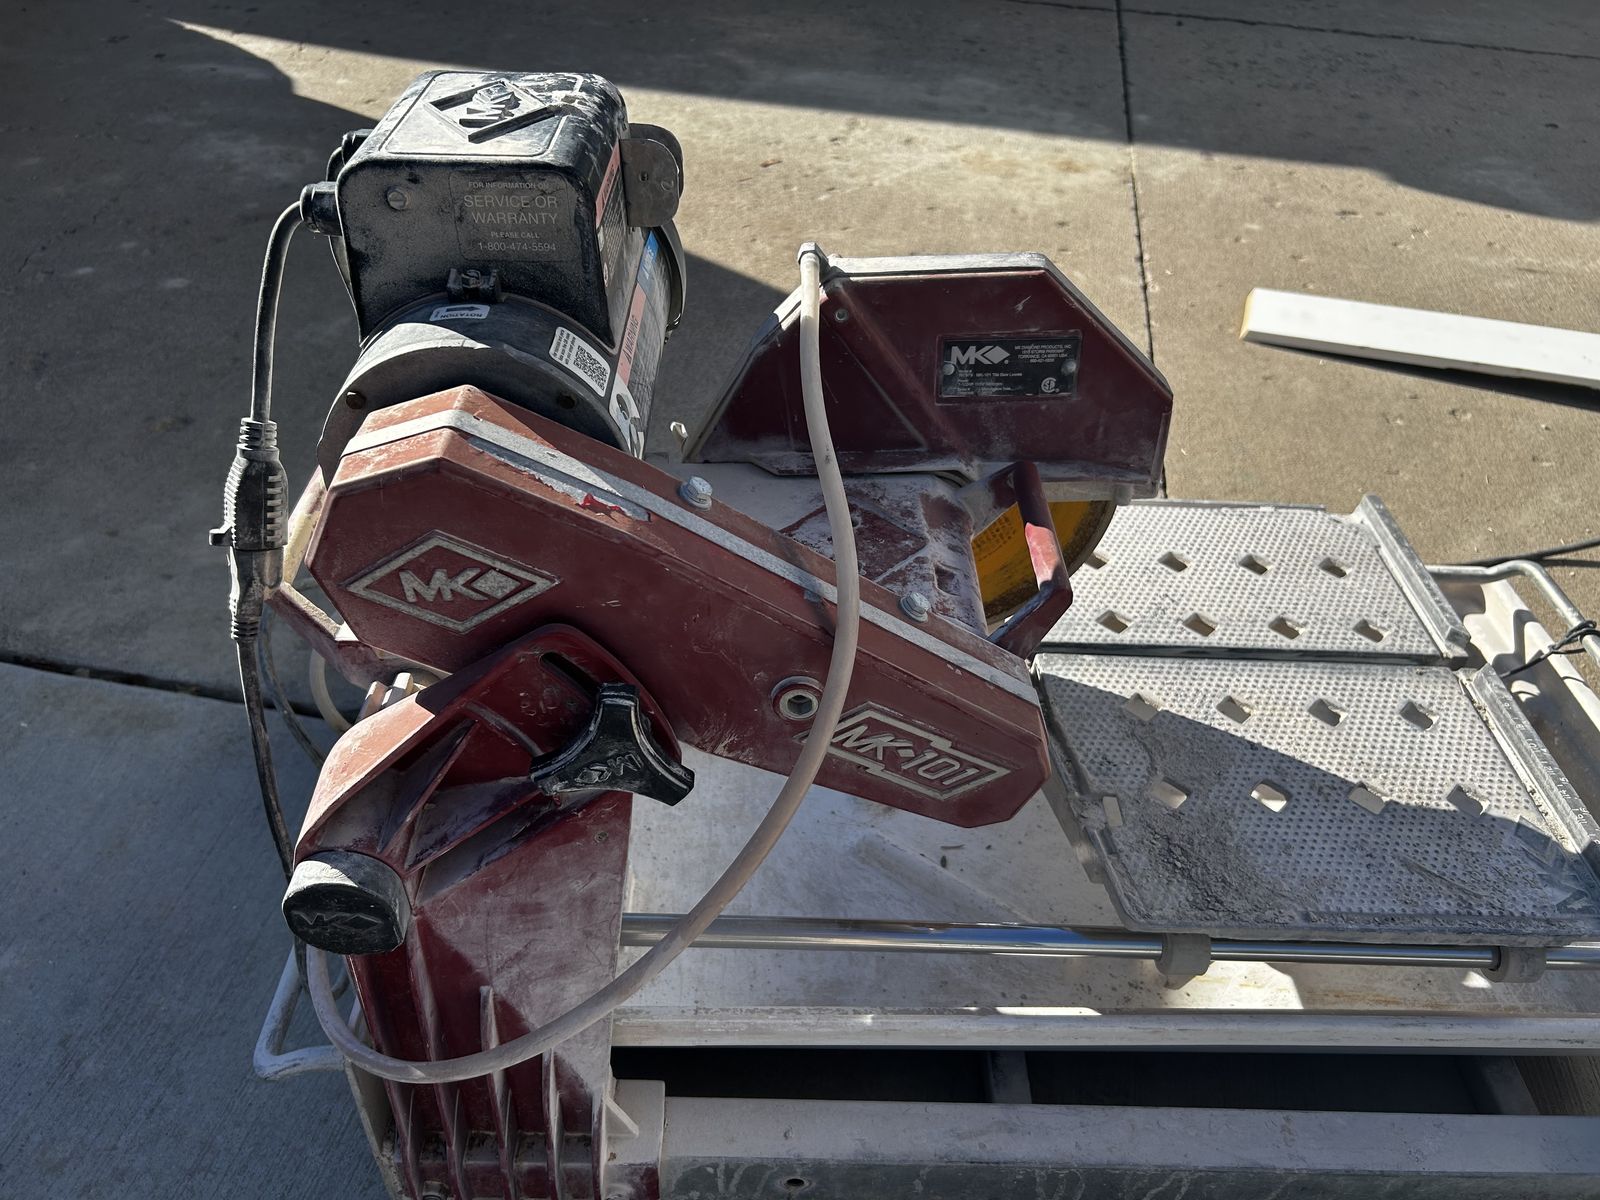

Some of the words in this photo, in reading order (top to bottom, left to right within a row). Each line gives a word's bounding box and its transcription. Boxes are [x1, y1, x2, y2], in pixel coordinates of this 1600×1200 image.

[464, 195, 530, 208] SERVICE
[535, 195, 558, 208] OR
[472, 212, 558, 225] WARRANTY
[478, 242, 556, 251] 1-800-474-5594
[625, 317, 639, 355] WARNING
[950, 345, 993, 365] MK
[399, 567, 489, 603] MK
[831, 725, 980, 786] MK-101
